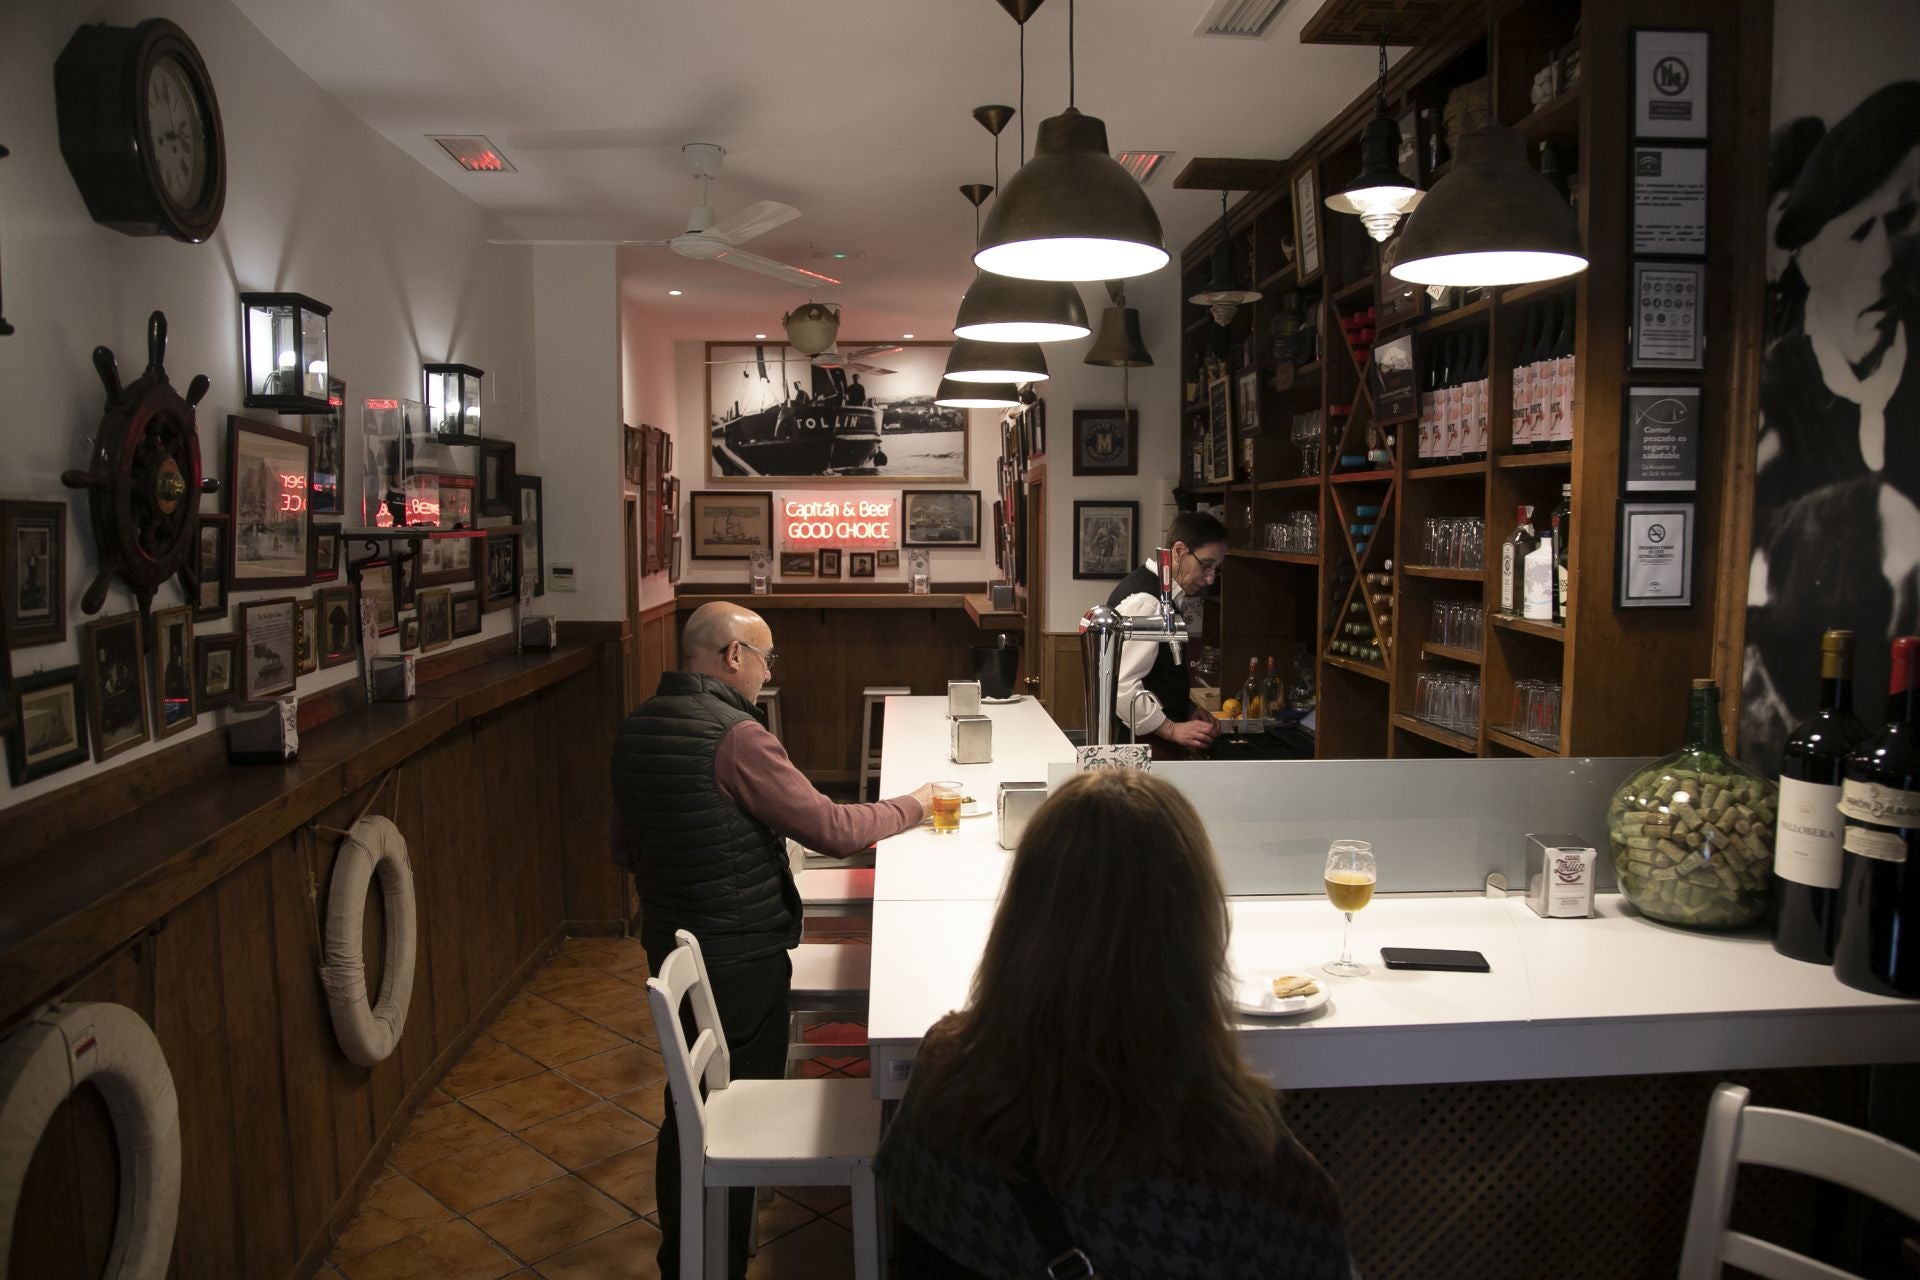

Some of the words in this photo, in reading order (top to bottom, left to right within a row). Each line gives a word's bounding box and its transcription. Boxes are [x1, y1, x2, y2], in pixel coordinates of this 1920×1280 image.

[796, 415, 858, 429] TOLLIN
[785, 500, 840, 520] Capitán
[843, 501, 856, 517] &
[859, 500, 892, 517] Beer
[788, 522, 834, 539] GOOD
[836, 522, 890, 539] CHOICE
[1554, 859, 1585, 875] Tollin
